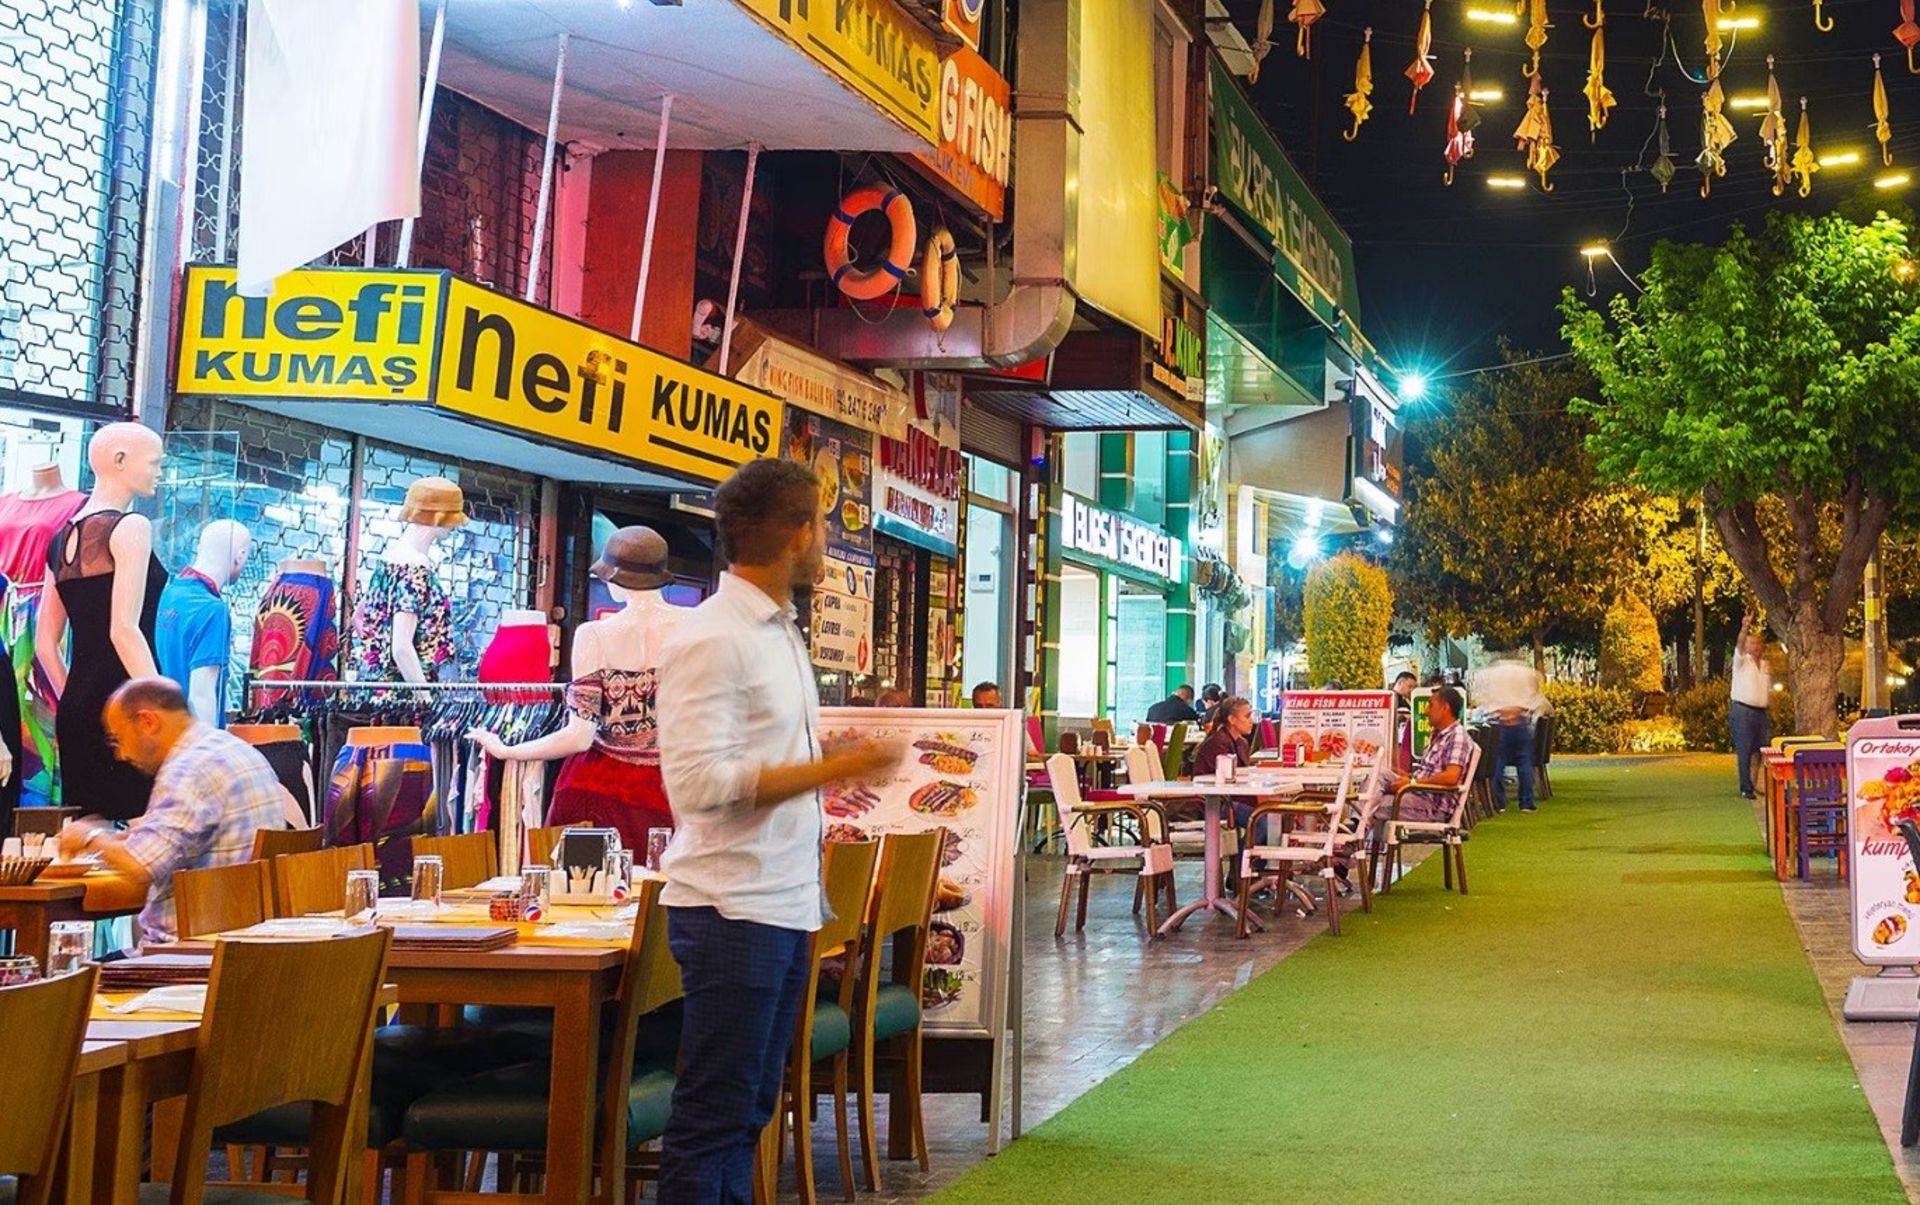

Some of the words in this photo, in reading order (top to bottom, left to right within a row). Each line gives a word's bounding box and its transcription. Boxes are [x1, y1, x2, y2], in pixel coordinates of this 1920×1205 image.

[961, 77, 1011, 188] FISH
[1230, 120, 1286, 250] BURSA
[200, 280, 426, 345] nefi
[194, 351, 417, 394] KUMAŞ
[456, 306, 627, 433] nefi
[1075, 500, 1118, 562] BURSA
[1861, 837, 1911, 860] kump
